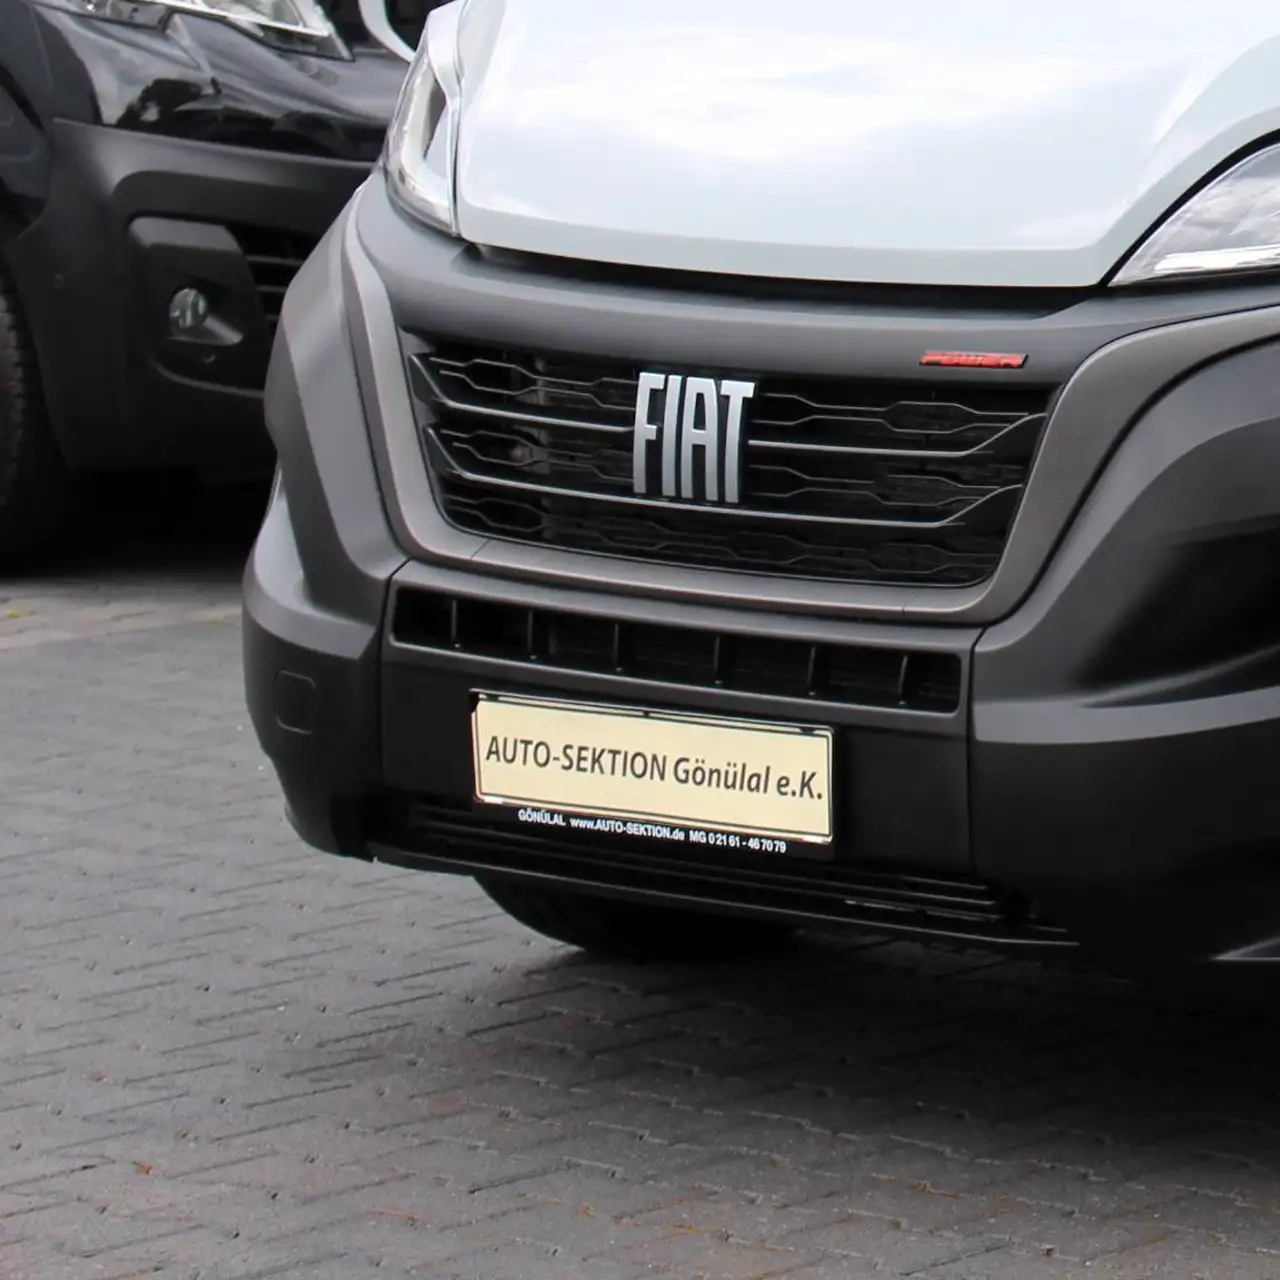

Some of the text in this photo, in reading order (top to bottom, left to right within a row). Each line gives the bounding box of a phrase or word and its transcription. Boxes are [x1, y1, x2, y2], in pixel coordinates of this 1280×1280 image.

[633, 372, 755, 504] FIAT
[485, 735, 823, 801] AUTO-SEKTION Gönülal e.K.
[518, 808, 567, 827] GÖNÜLAL
[570, 818, 686, 841] www.AUTO-SEKTION.de
